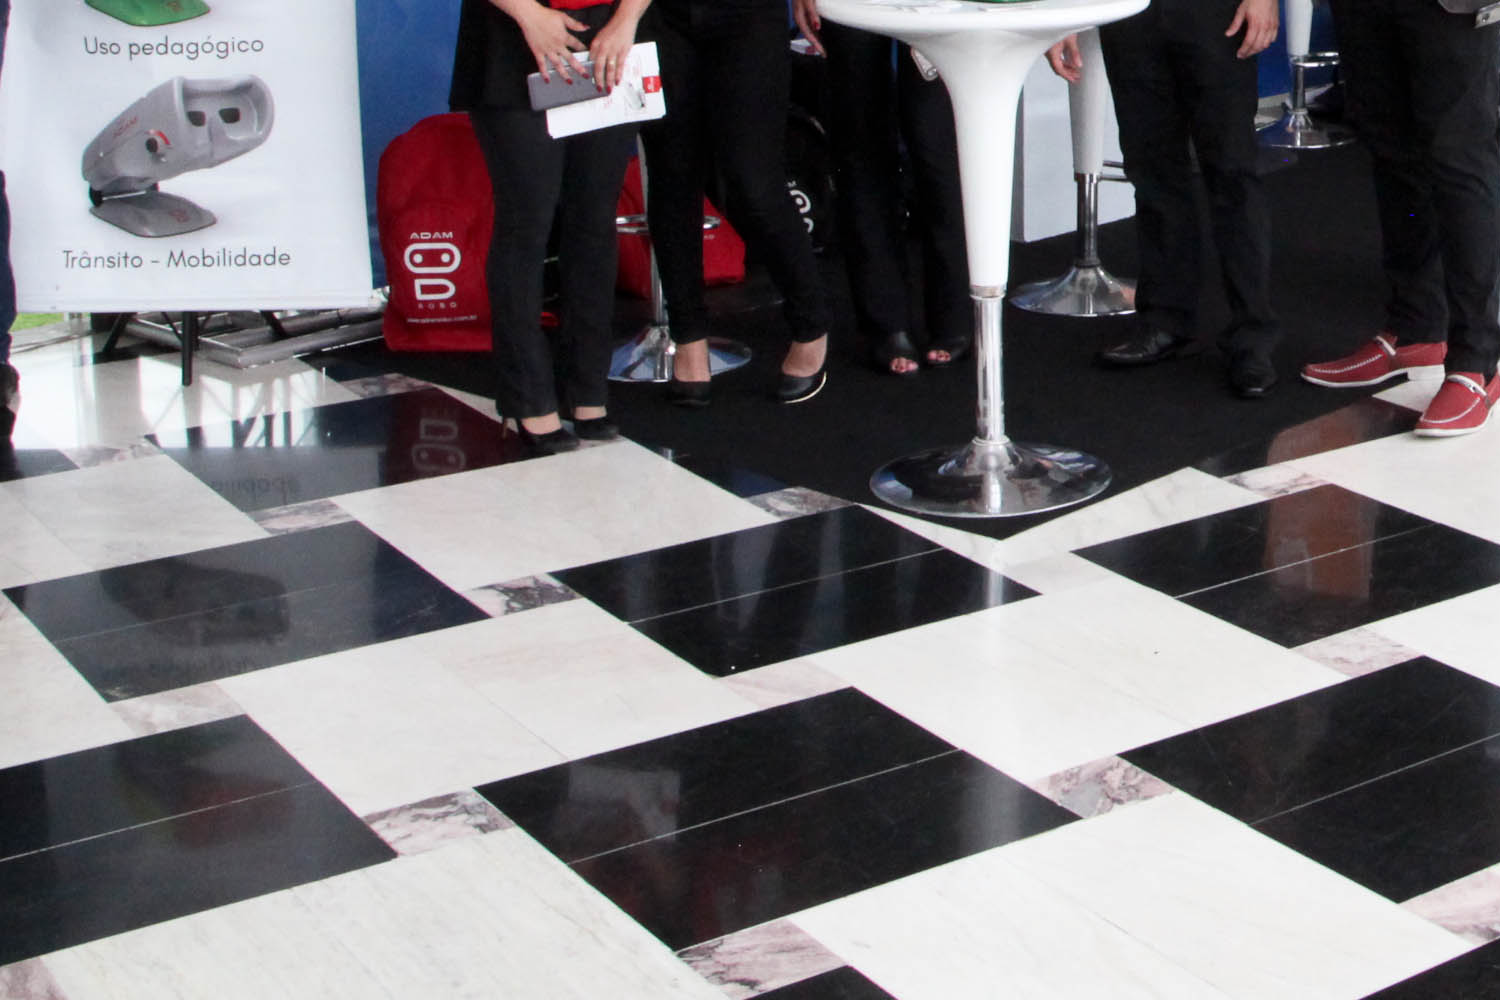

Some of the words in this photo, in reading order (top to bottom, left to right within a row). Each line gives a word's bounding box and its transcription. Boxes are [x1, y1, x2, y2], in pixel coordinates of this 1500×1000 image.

[83, 36, 122, 56] Uso
[127, 34, 265, 61] pedagógico
[409, 231, 454, 240] ADAM
[62, 249, 144, 269] Trânsito
[167, 246, 292, 269] Mobilidade
